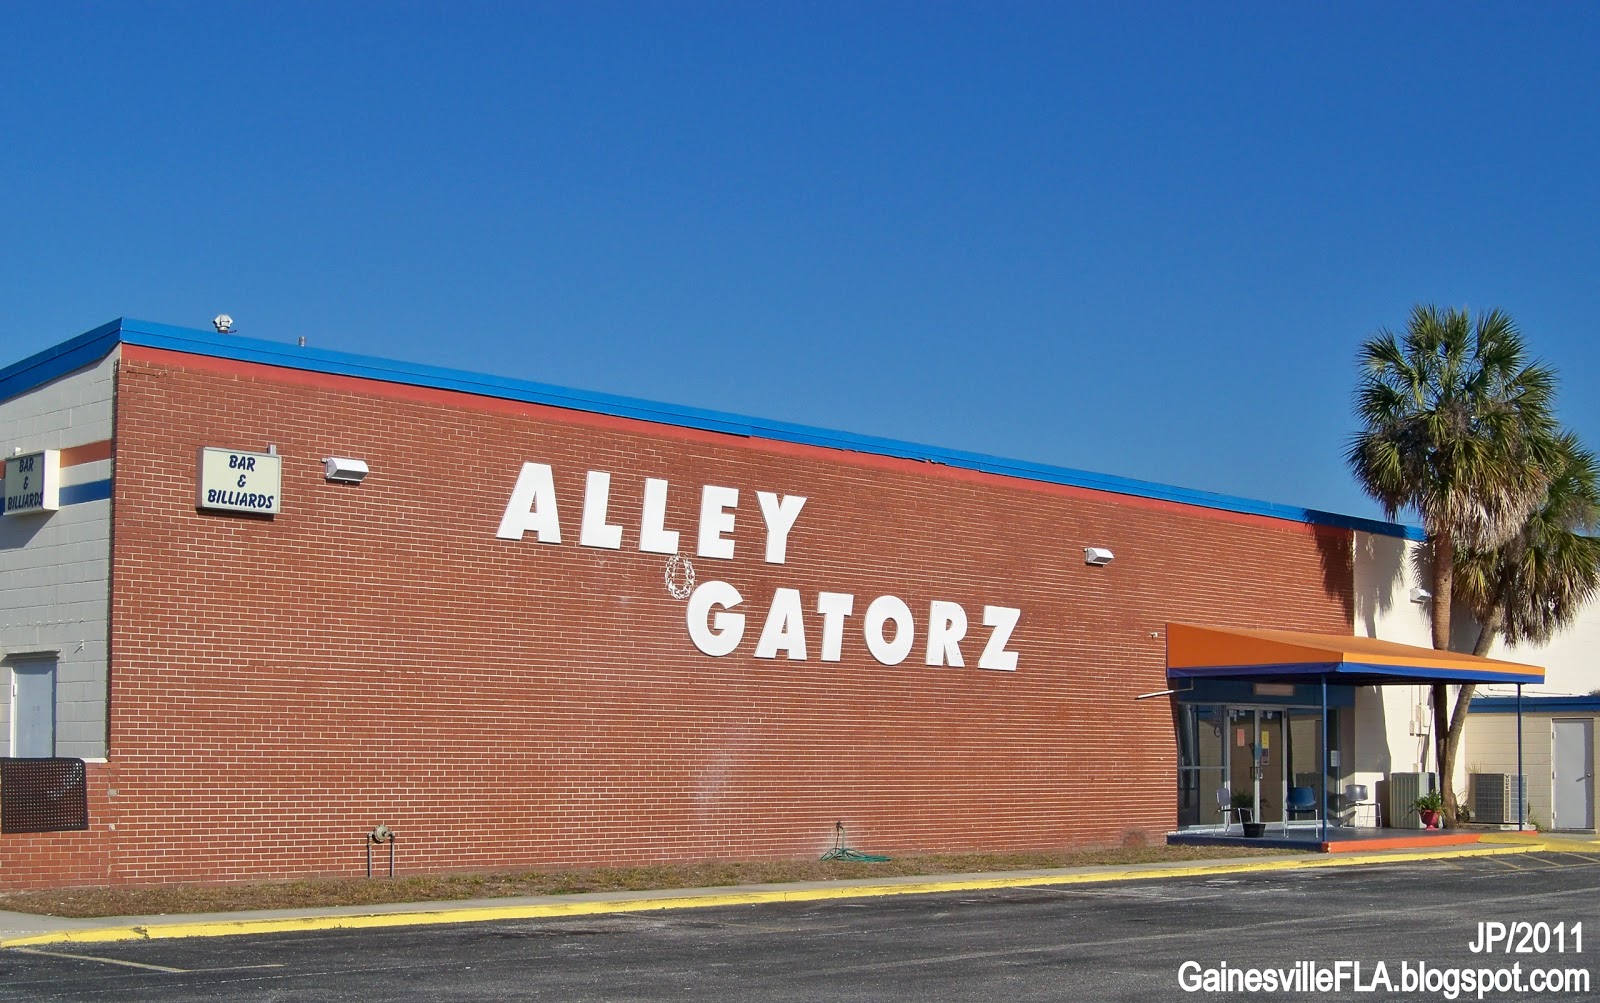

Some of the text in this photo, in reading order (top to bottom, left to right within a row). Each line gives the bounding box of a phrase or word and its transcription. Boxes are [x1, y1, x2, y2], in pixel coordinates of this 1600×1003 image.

[19, 457, 34, 473] BAR
[229, 455, 256, 473] BAR
[23, 476, 29, 490] &
[237, 474, 247, 488] &
[7, 491, 44, 511] BILLIARDS
[207, 489, 274, 509] BILLIARDS
[496, 462, 807, 564] ALLEY
[686, 580, 1021, 671] GATORZ
